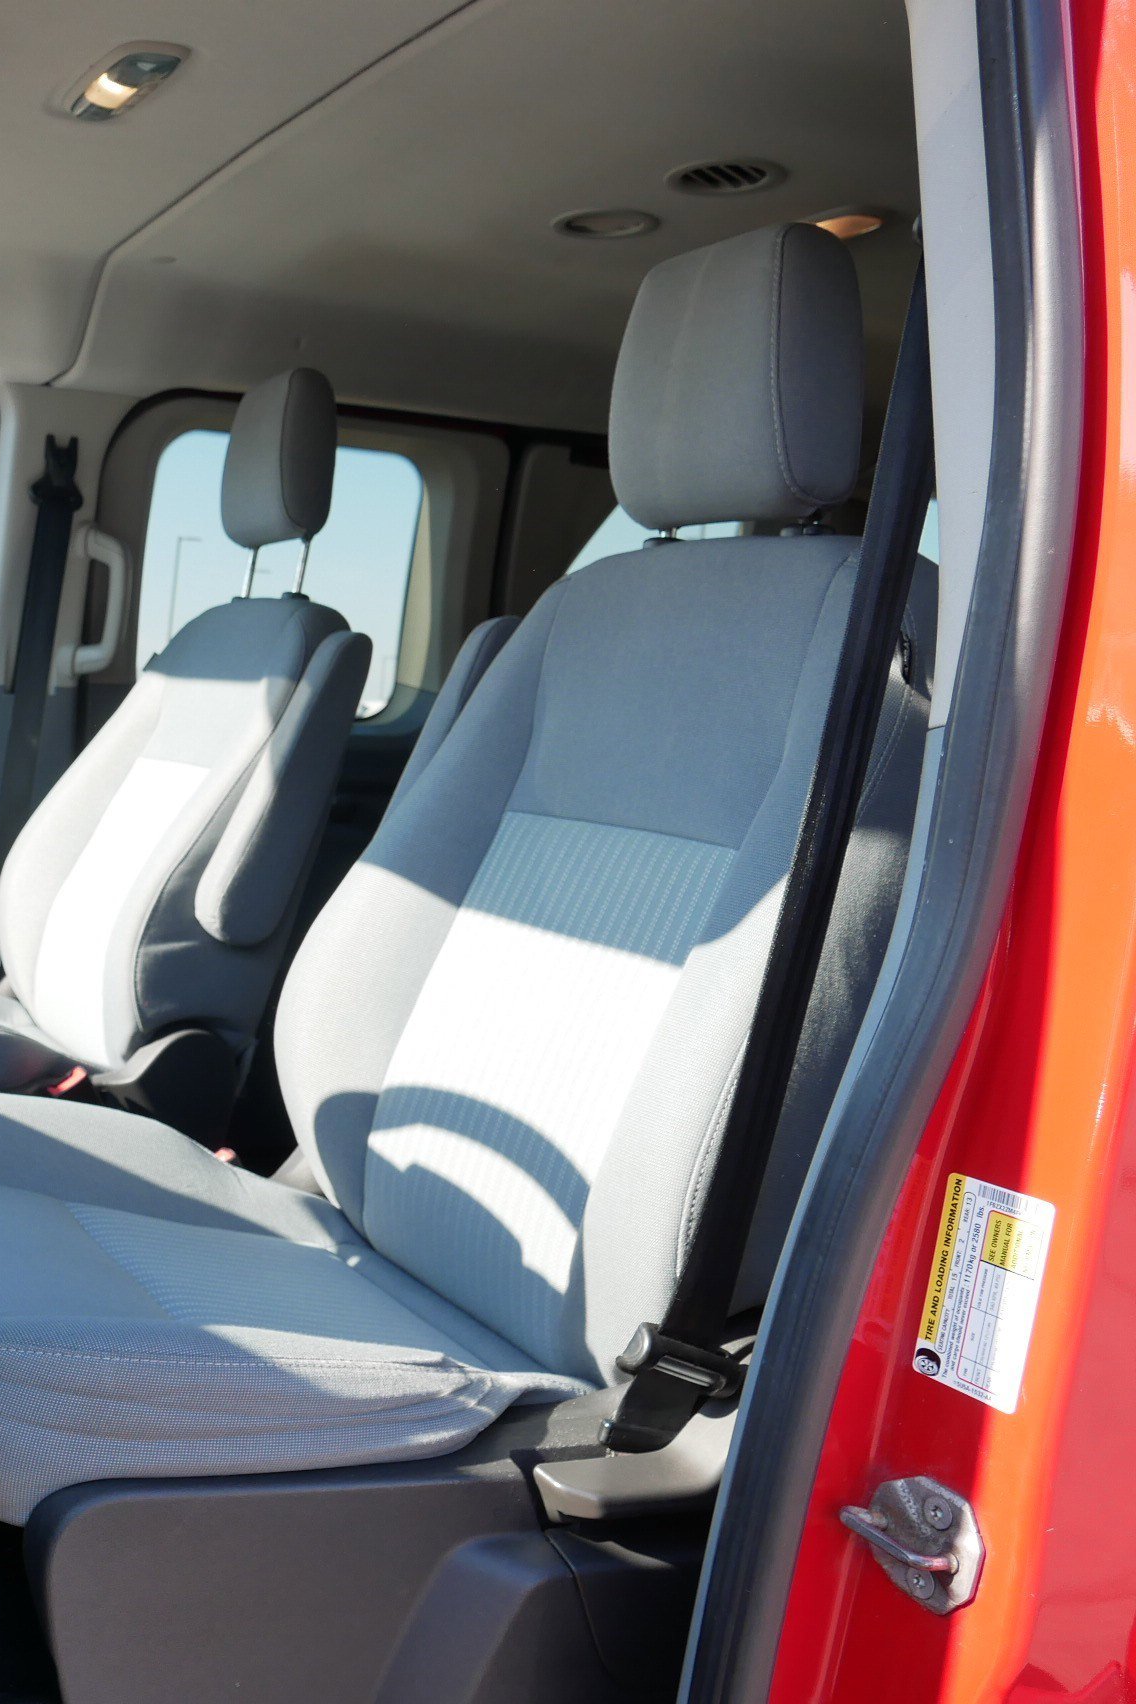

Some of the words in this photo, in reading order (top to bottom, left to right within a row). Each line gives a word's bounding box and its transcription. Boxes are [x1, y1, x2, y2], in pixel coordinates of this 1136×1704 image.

[943, 1178, 963, 1247] INFORMATION
[976, 1204, 985, 1218] lbs.
[971, 1222, 982, 1243] 2580
[991, 1219, 1003, 1248] OWNERS
[999, 1238, 1011, 1266] MANUAL
[1005, 1222, 1014, 1236] FOR
[971, 1244, 977, 1252] or
[988, 1250, 996, 1262] SEE
[934, 1249, 949, 1293] LOADING
[938, 1331, 946, 1351] SEATING
[942, 1308, 951, 1331] CAPACITY
[948, 1285, 956, 1300] TOTAL
[952, 1272, 958, 1281] 15
[966, 1196, 973, 1205] 13
[964, 1253, 977, 1283] 1170kg
[930, 1294, 940, 1316] AND
[925, 1317, 936, 1341] TIRE
[944, 1341, 954, 1367] combined
[949, 1321, 959, 1340] weight
[955, 1286, 966, 1314] occupants
[955, 1325, 963, 1343] should
